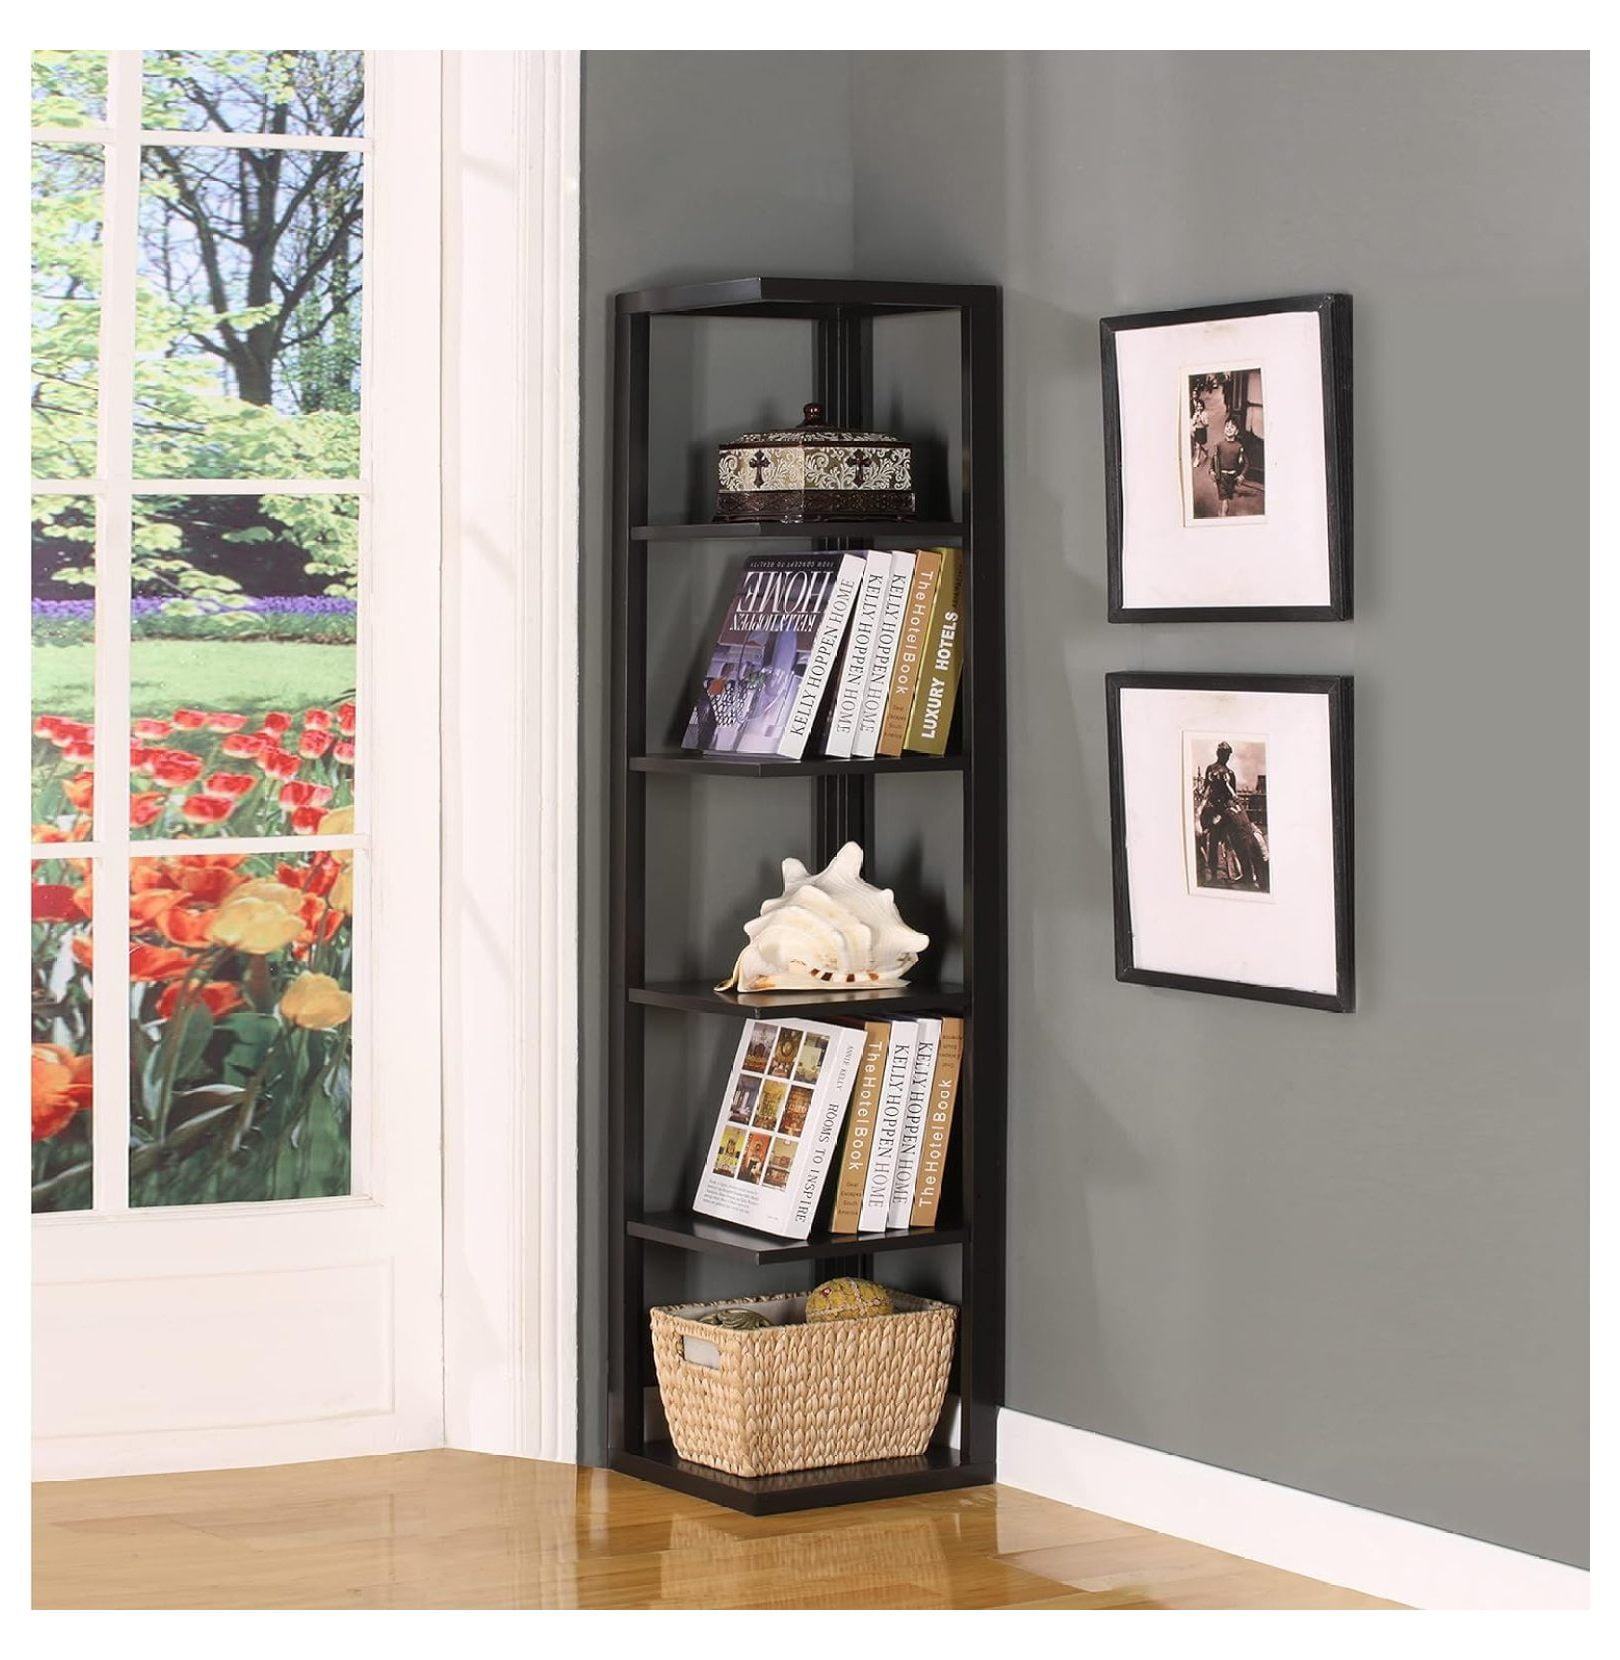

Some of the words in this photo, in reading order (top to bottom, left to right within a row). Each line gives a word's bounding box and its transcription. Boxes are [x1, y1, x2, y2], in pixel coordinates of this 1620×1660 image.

[736, 571, 834, 614] HOME
[862, 574, 883, 620] KELLY
[884, 574, 906, 620] KELLY
[729, 613, 779, 632] HOPPEN
[777, 613, 817, 632] KELLY
[790, 689, 816, 736] KELLY
[807, 626, 838, 688] HOPPEN
[829, 579, 855, 623] HOME
[847, 622, 873, 685] HOPPEN
[870, 622, 896, 685] HOPPEN
[921, 677, 945, 739] LUXURY
[934, 611, 958, 671] HOTELS
[837, 688, 858, 733] HOME
[859, 688, 882, 733] HOME
[889, 1044, 909, 1091] KELLY
[912, 1041, 933, 1088] KELLY
[819, 1103, 839, 1143] ROOMS
[878, 1094, 901, 1158] HOPPEN
[901, 1091, 925, 1155] HOPPEN
[812, 1149, 826, 1164] TO
[795, 1169, 819, 1222] INSPIRE
[868, 1163, 890, 1207] HOME
[893, 1159, 913, 1204] HOME
